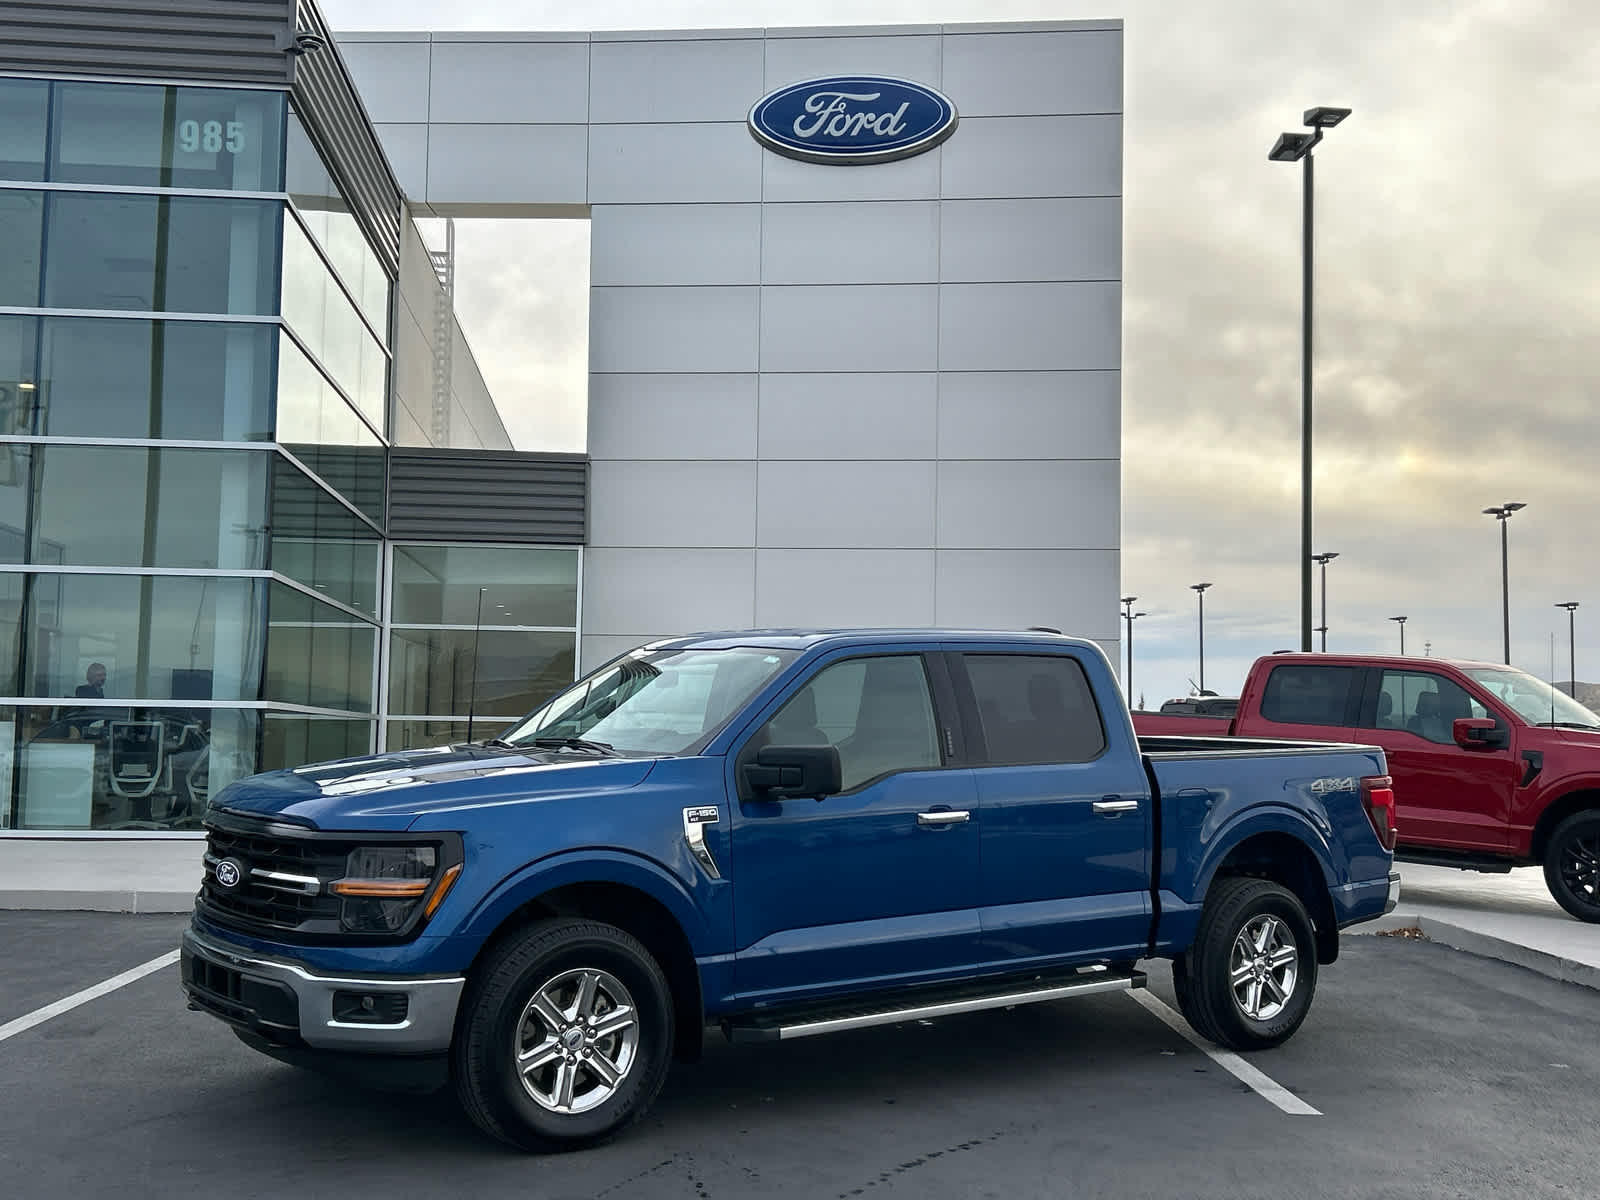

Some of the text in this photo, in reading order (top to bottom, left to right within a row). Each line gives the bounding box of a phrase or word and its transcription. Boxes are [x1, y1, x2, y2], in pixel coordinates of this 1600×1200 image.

[793, 91, 910, 138] Ford
[179, 119, 245, 154] 985
[688, 809, 717, 818] F-150
